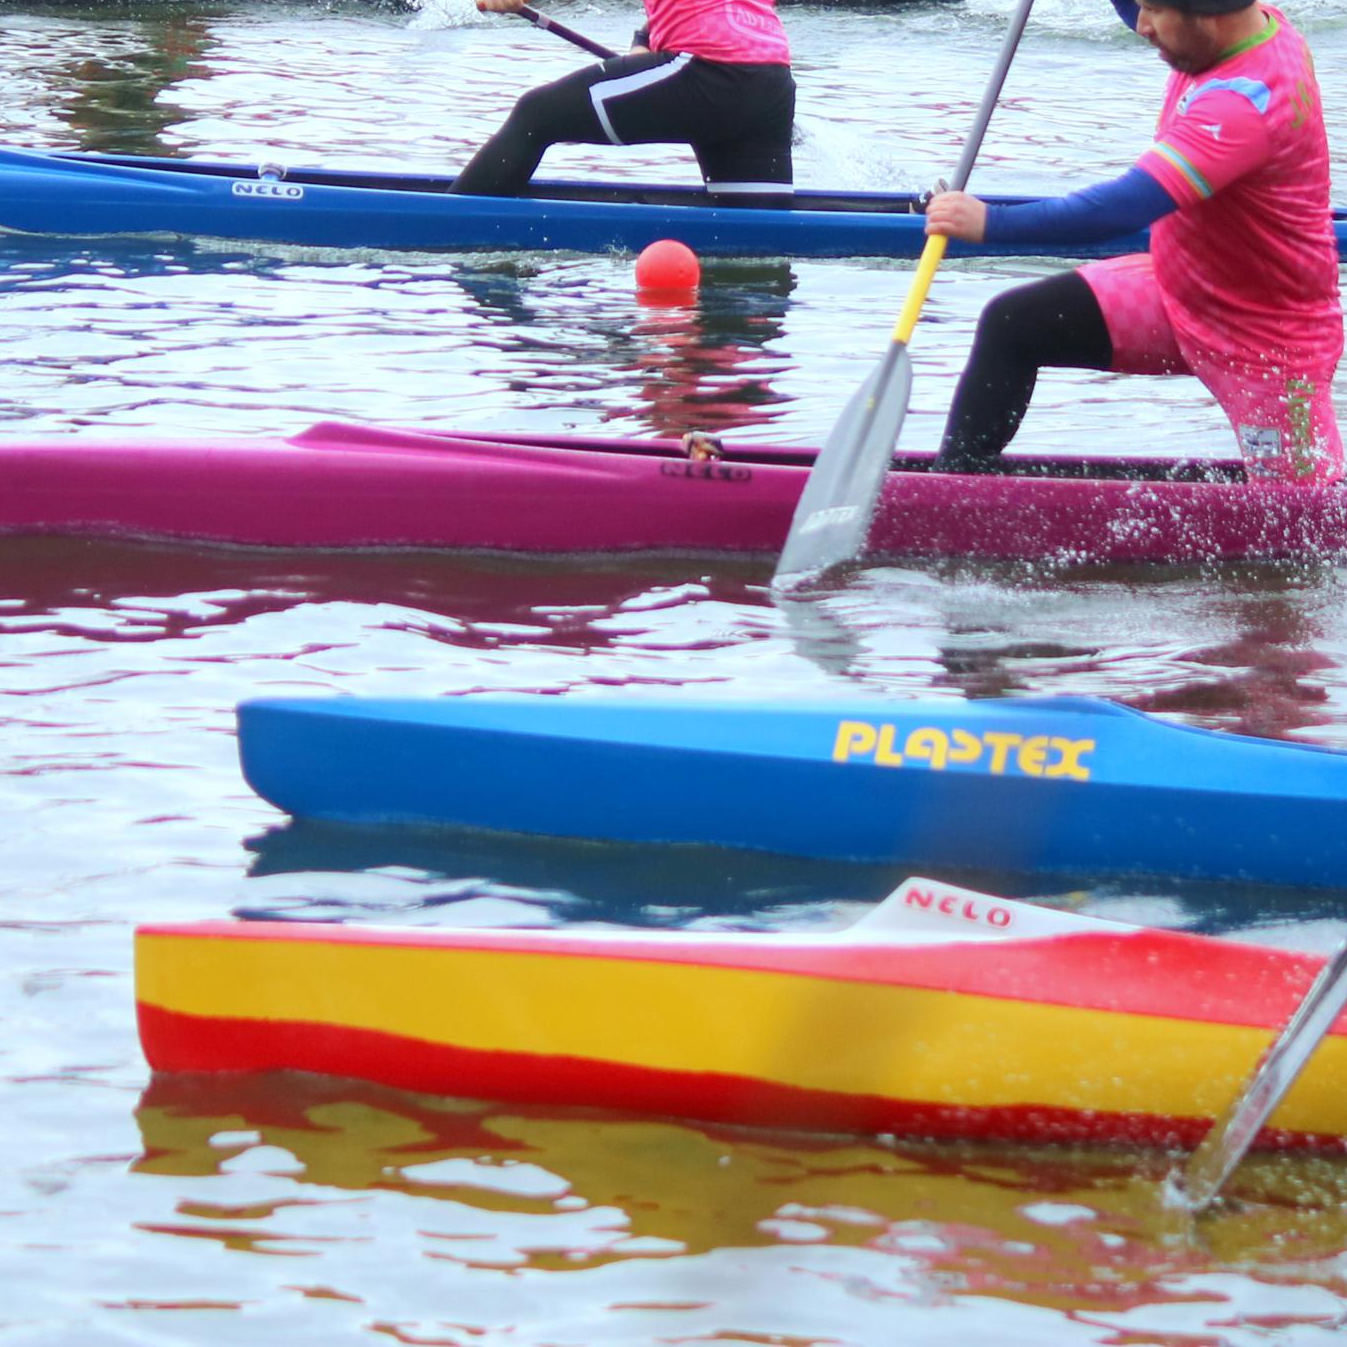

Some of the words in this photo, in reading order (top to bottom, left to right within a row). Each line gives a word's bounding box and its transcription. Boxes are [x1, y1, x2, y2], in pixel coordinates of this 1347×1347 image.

[235, 184, 301, 197] NELO
[832, 720, 1096, 782] PLASTEX
[905, 888, 1012, 928] NELO
